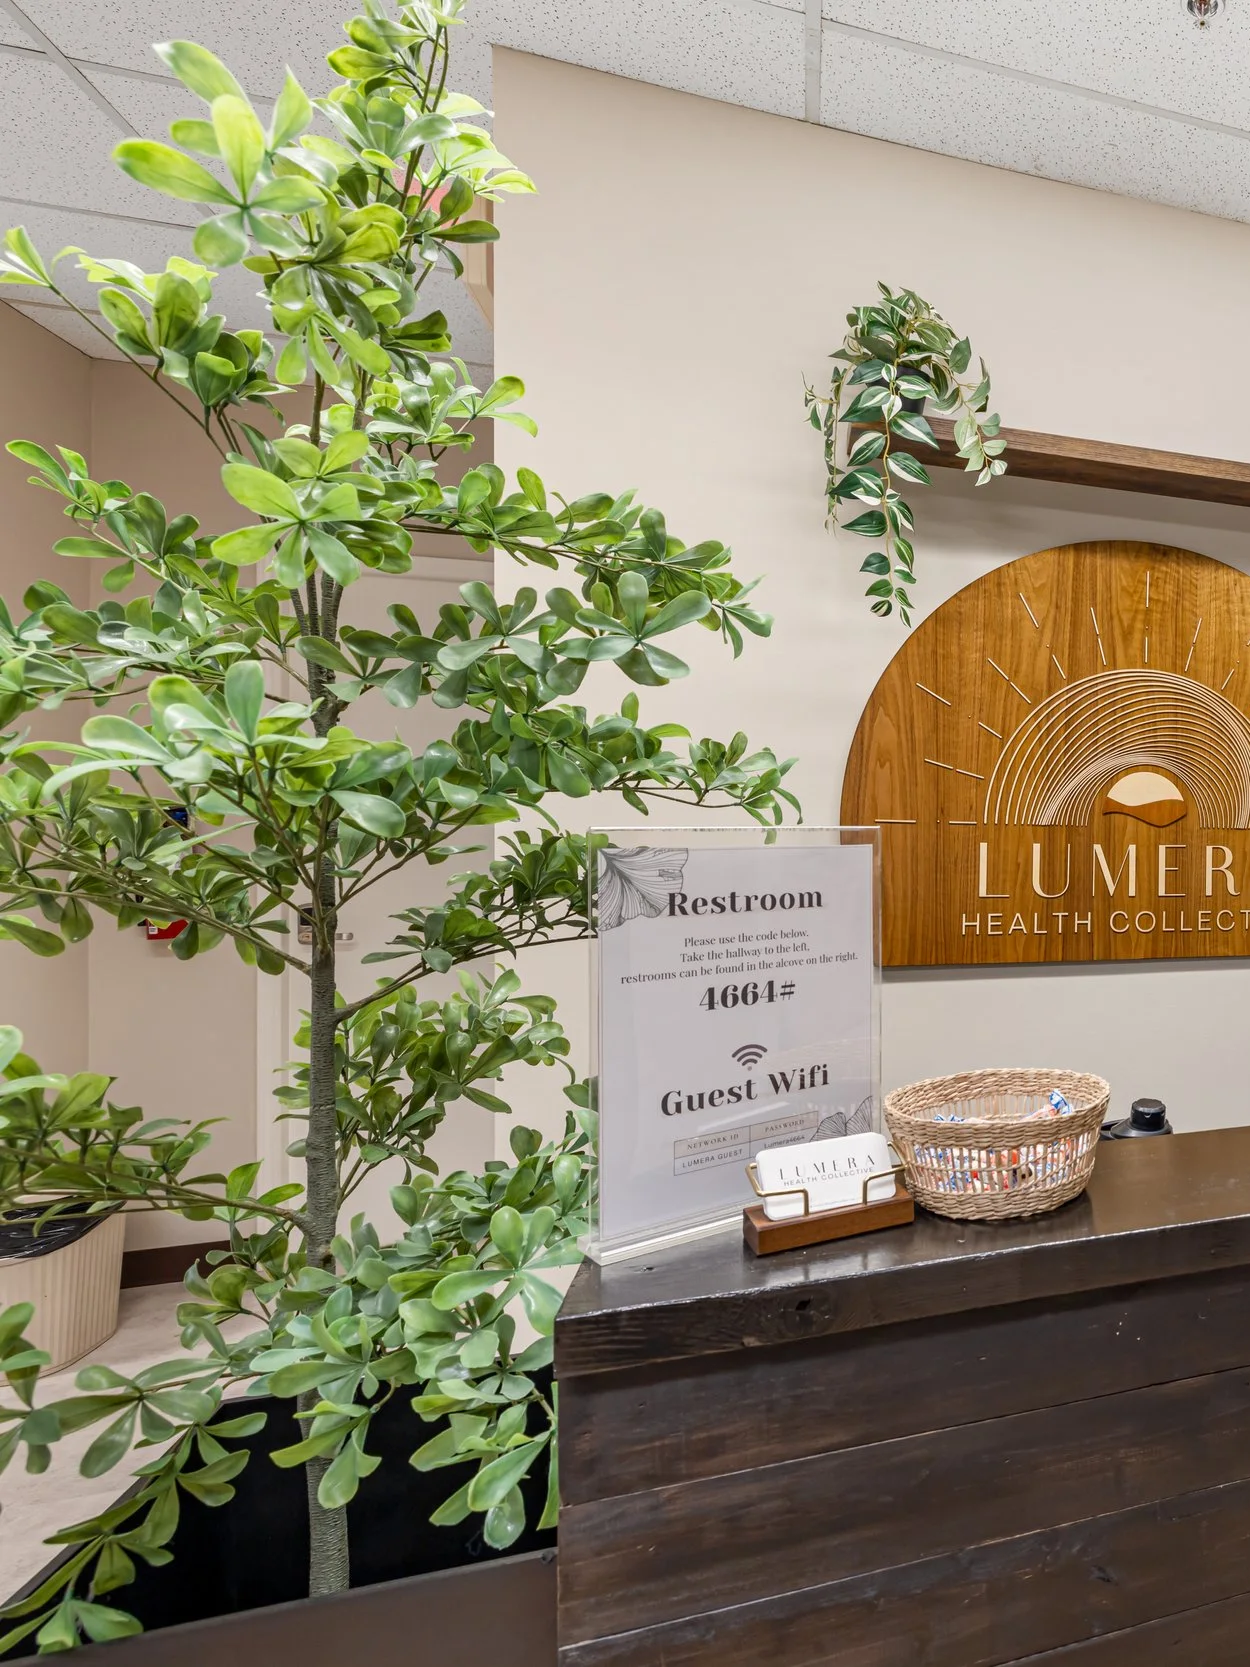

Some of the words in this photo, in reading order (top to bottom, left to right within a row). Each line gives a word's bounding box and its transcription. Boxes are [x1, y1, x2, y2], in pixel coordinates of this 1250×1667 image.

[667, 890, 824, 917] Restroom
[962, 911, 1092, 935] HEALTH
[684, 936, 717, 948] Please
[719, 935, 736, 945] use
[738, 933, 754, 943] the
[755, 931, 778, 942] code
[780, 929, 809, 939] below.
[680, 953, 705, 963] Take
[707, 950, 723, 961] the
[725, 947, 762, 959] hallway
[764, 946, 774, 955] to
[776, 944, 791, 954] the
[792, 942, 810, 952] left.
[620, 970, 677, 985] restrooms
[679, 969, 698, 979] can
[700, 965, 713, 976] be
[715, 963, 744, 974] found
[746, 961, 757, 971] in
[758, 960, 774, 970] the
[775, 956, 805, 968] alcove
[806, 956, 818, 965] on
[819, 954, 834, 964] the
[835, 951, 858, 963] right.
[699, 979, 796, 1012] 4664#
[661, 1079, 759, 1117] Guest
[767, 1064, 829, 1095] Wifi
[765, 1119, 805, 1133] PASSWORD
[687, 1136, 727, 1150] NETWORK
[682, 1156, 715, 1168] LUMERA
[717, 1149, 743, 1160] GUEST
[779, 1154, 875, 1180] LUMERA
[784, 1176, 818, 1187] HEALTH
[820, 1167, 874, 1180] COLLECTIVE
